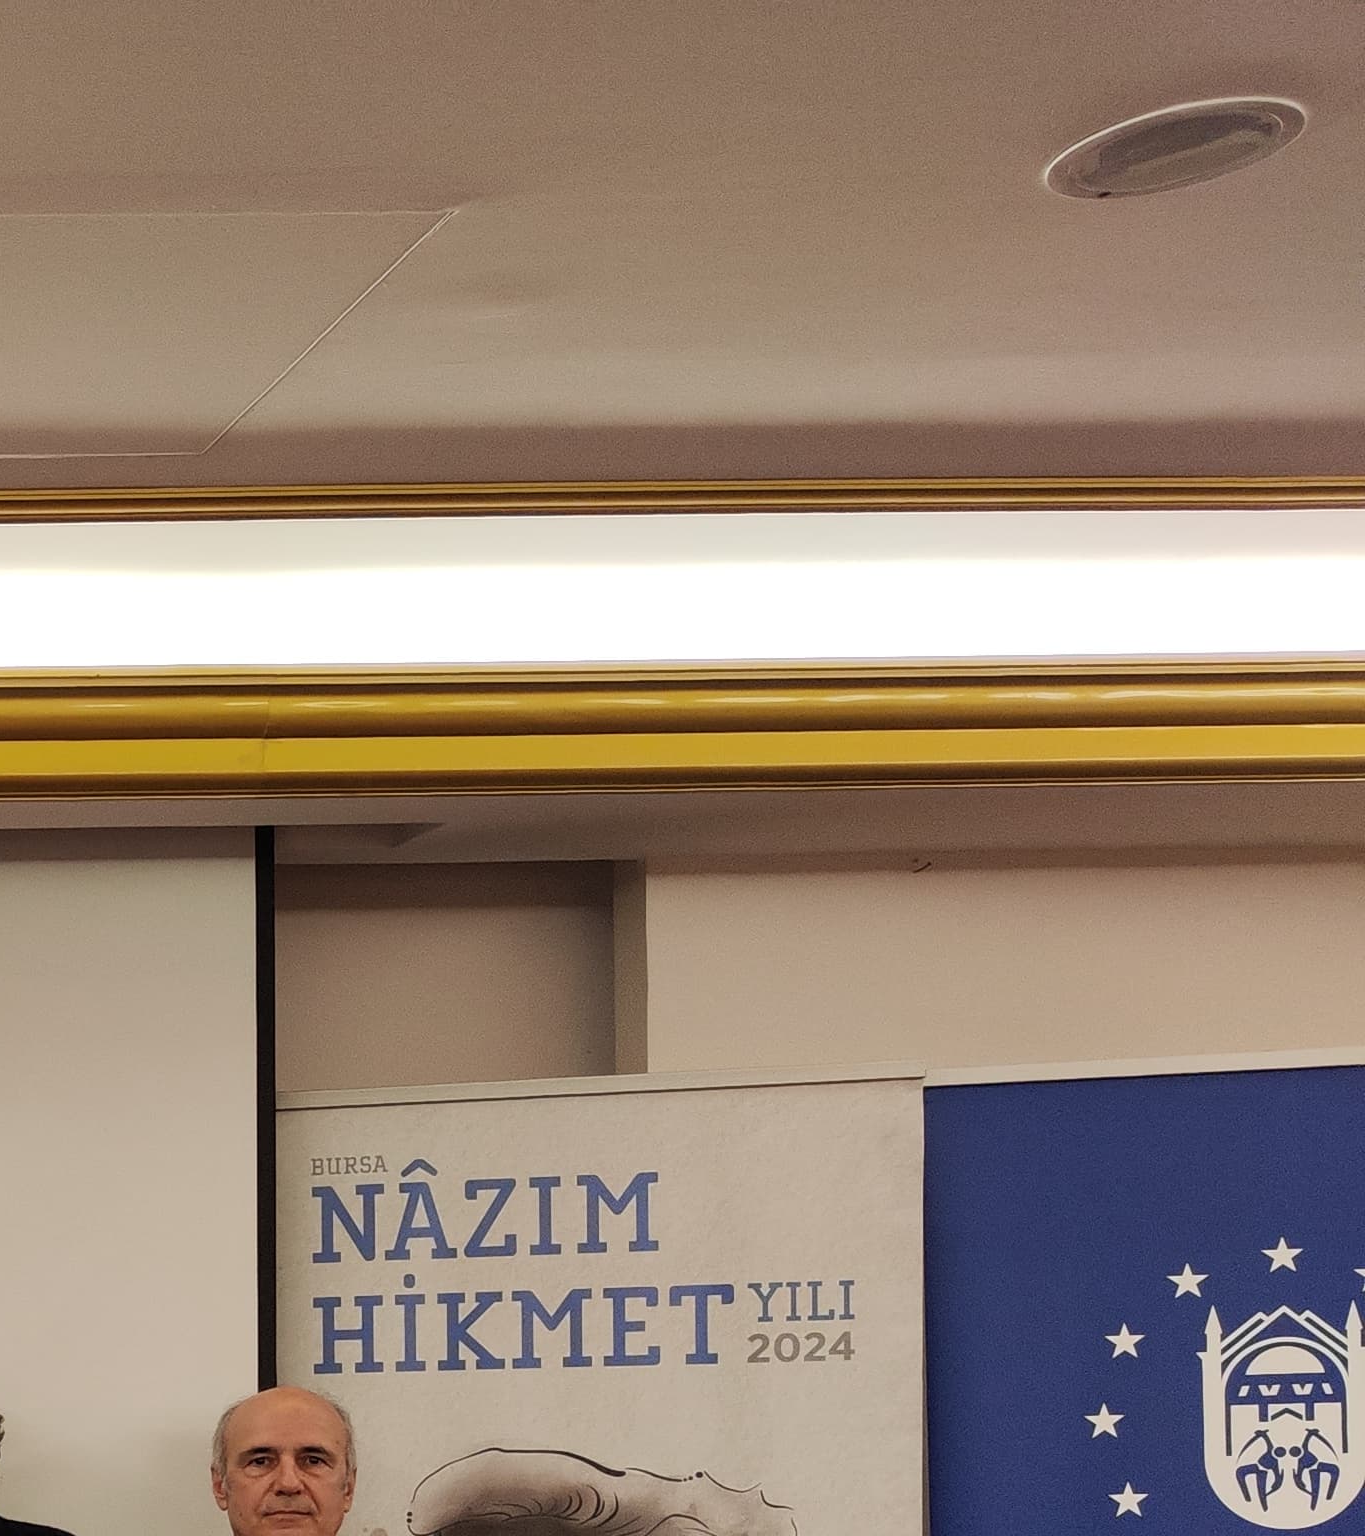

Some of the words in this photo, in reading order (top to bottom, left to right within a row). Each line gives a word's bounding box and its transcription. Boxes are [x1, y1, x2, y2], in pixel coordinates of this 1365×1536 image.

[310, 1155, 388, 1176] BURSA
[311, 1158, 659, 1264] NÂZIM
[312, 1274, 734, 1375] HİKMET
[747, 1279, 856, 1323] YILI
[746, 1330, 856, 1364] 2024
